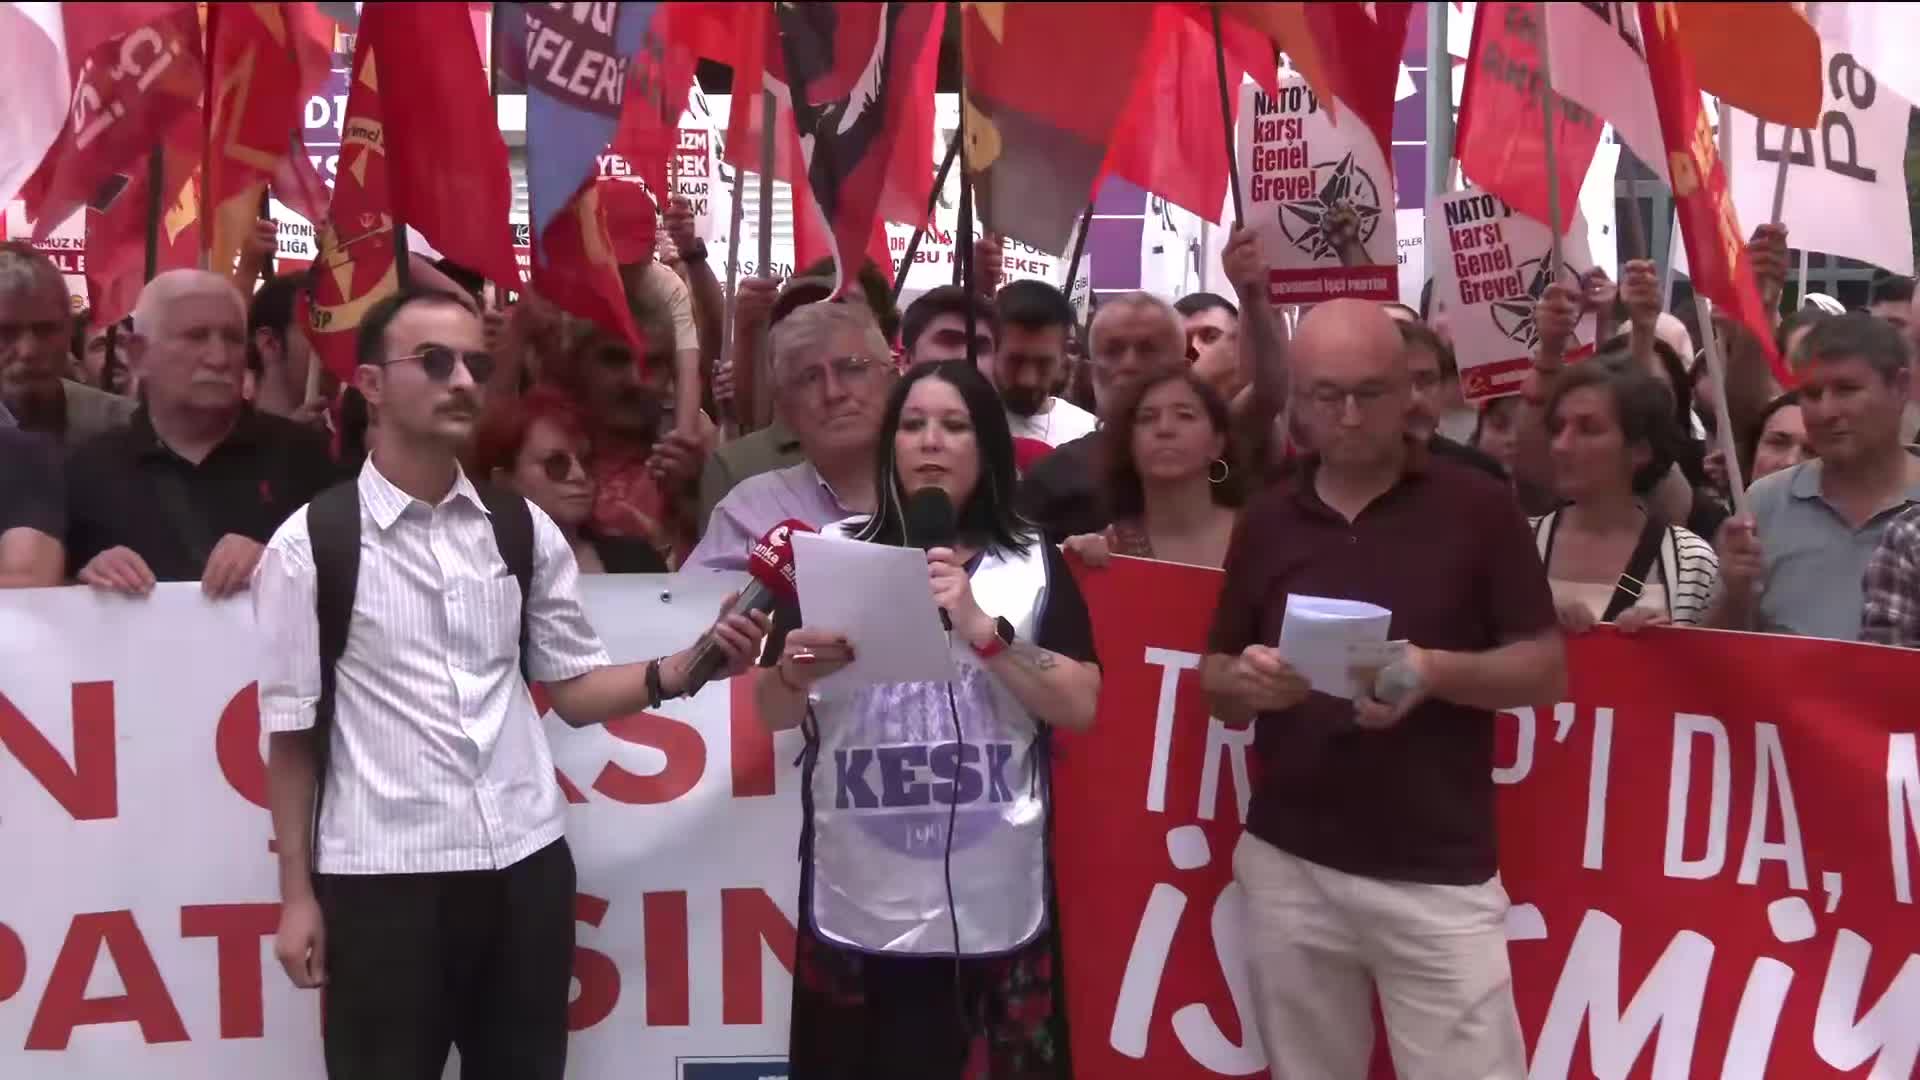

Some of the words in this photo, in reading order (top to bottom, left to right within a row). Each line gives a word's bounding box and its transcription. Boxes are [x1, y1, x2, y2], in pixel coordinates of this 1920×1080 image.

[1253, 117, 1303, 146] karşı
[1251, 141, 1309, 173] Genel
[1250, 170, 1317, 203] Greve!
[1448, 222, 1503, 252] karşı
[1453, 244, 1513, 279] Genel
[1457, 270, 1525, 305] Greve!
[834, 742, 1014, 809] KESK
[1663, 712, 1843, 914] DA,
